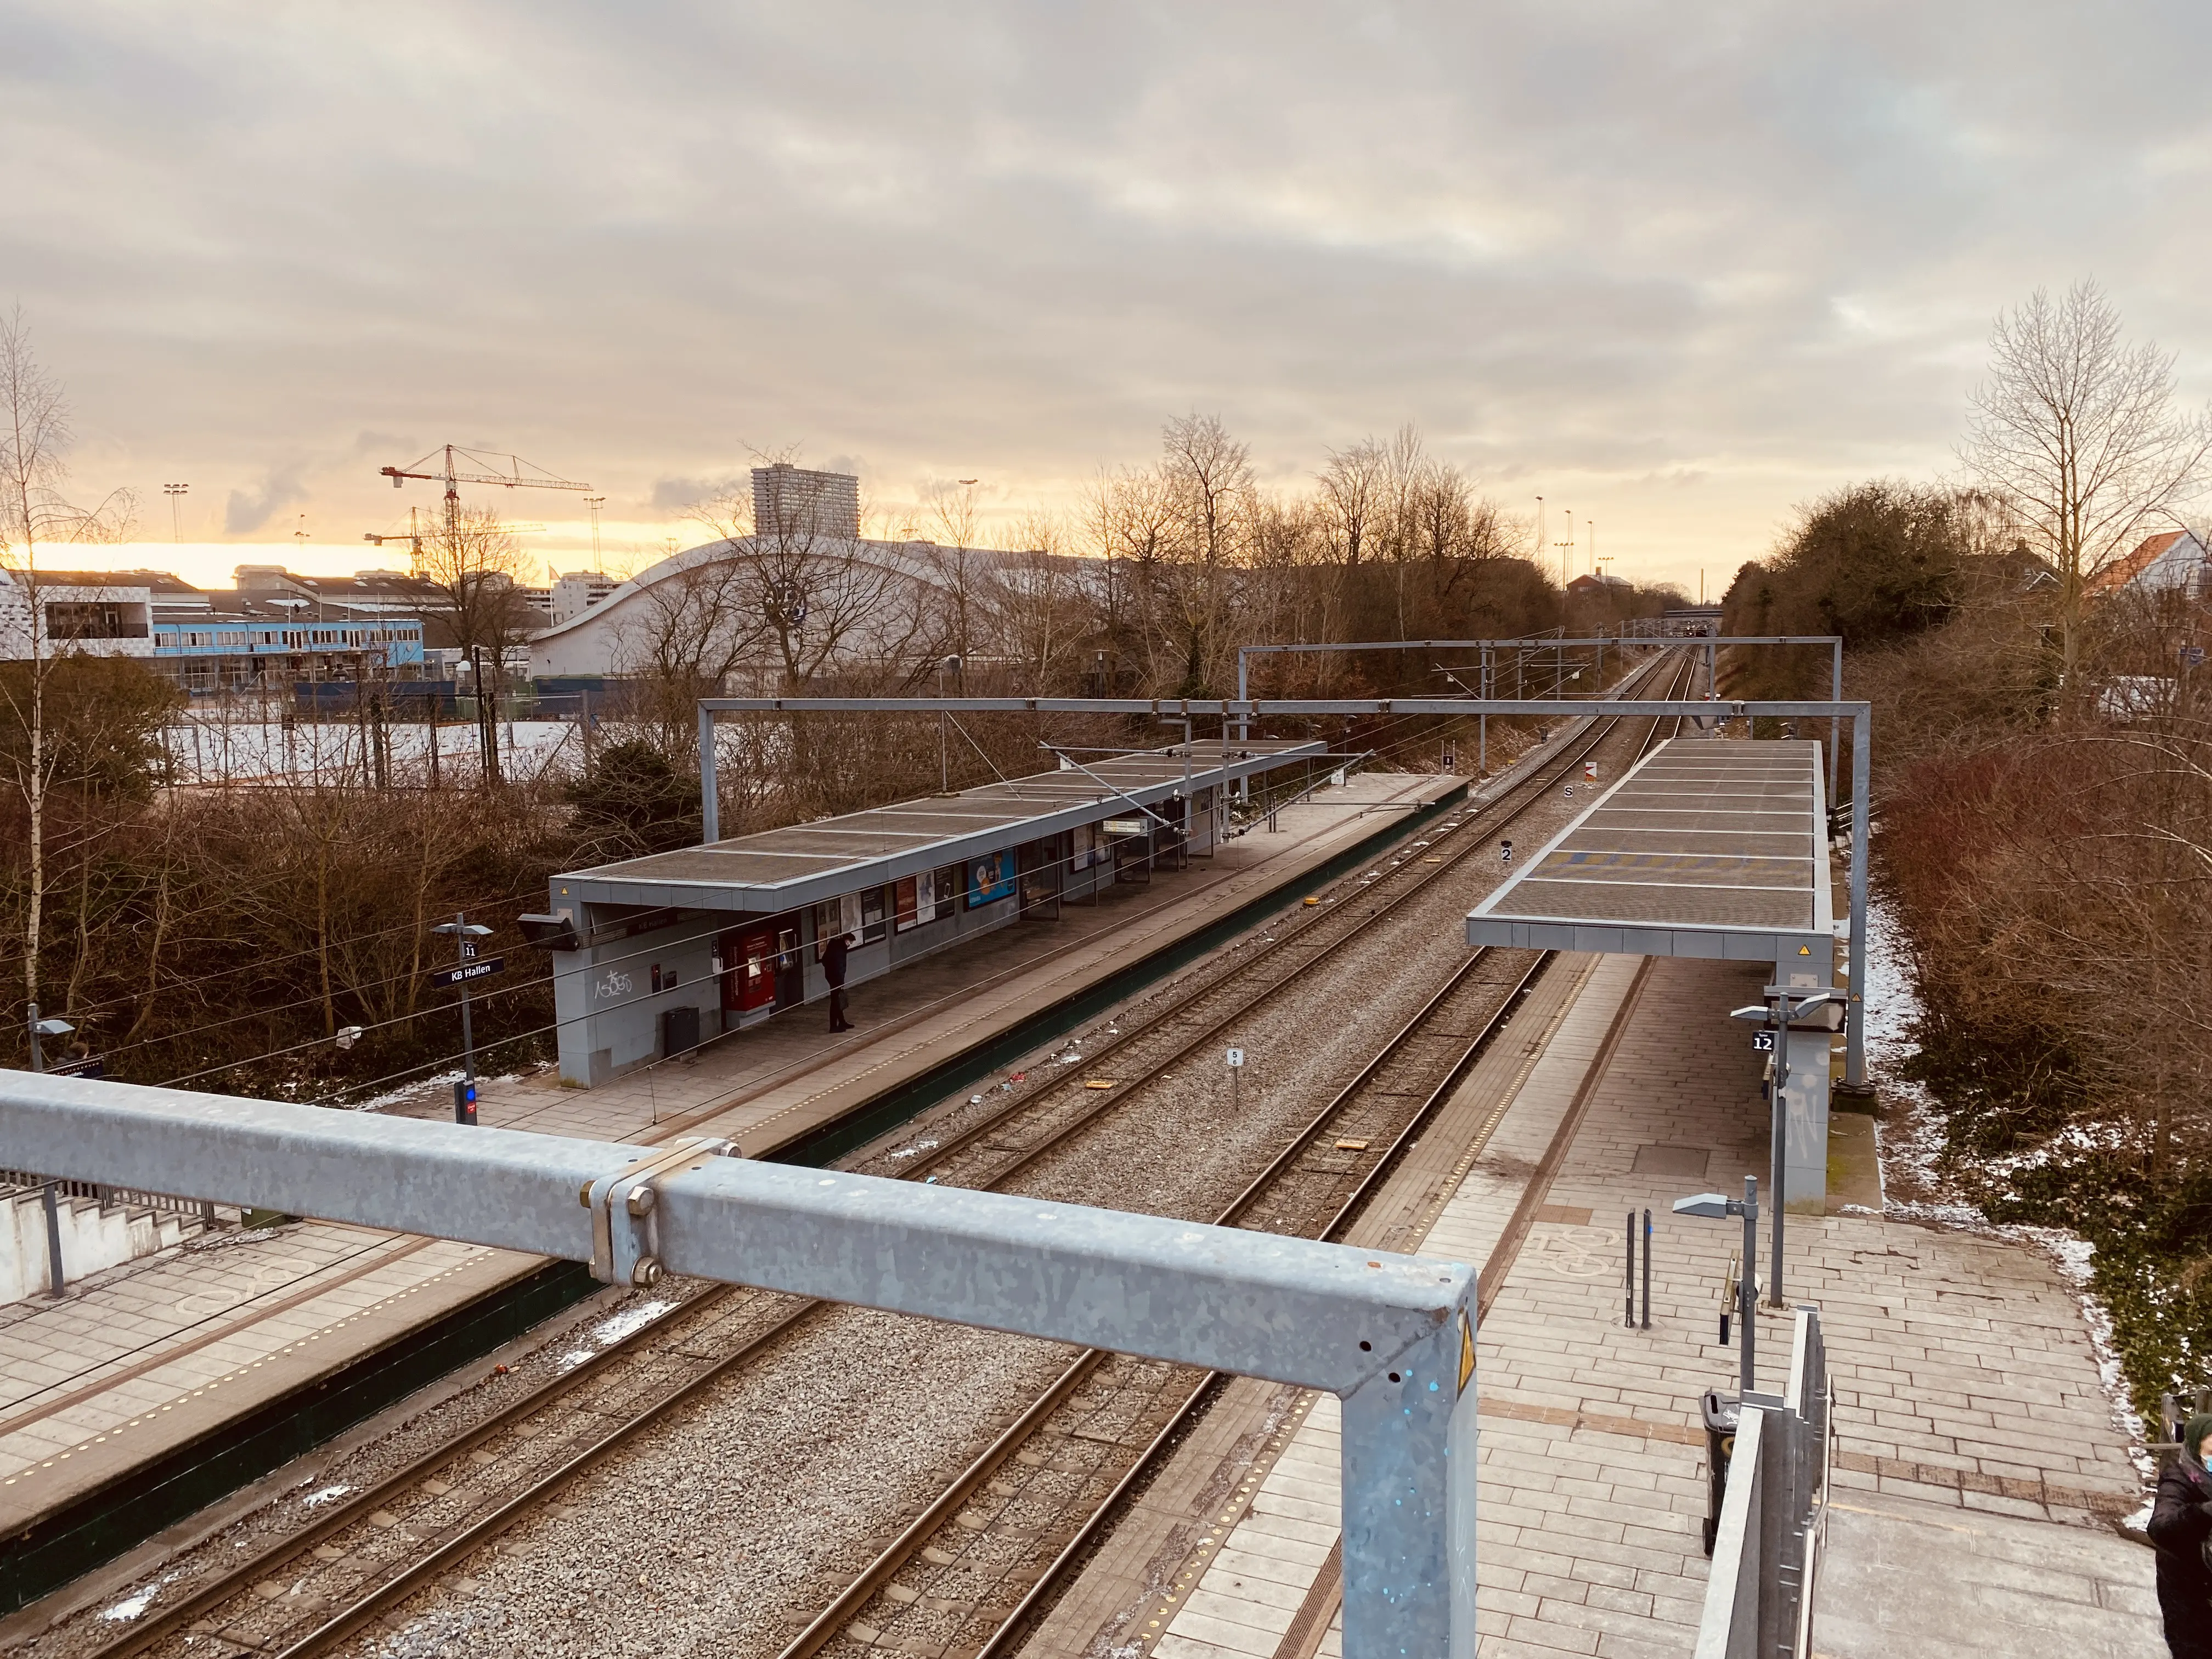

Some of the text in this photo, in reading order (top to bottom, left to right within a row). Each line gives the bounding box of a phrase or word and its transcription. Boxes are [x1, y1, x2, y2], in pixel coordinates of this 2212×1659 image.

[1565, 787, 1573, 796] S
[1502, 849, 1510, 860] 2
[466, 947, 476, 956] 11
[452, 965, 490, 981] KB Hallen
[1753, 1037, 1772, 1050] 12
